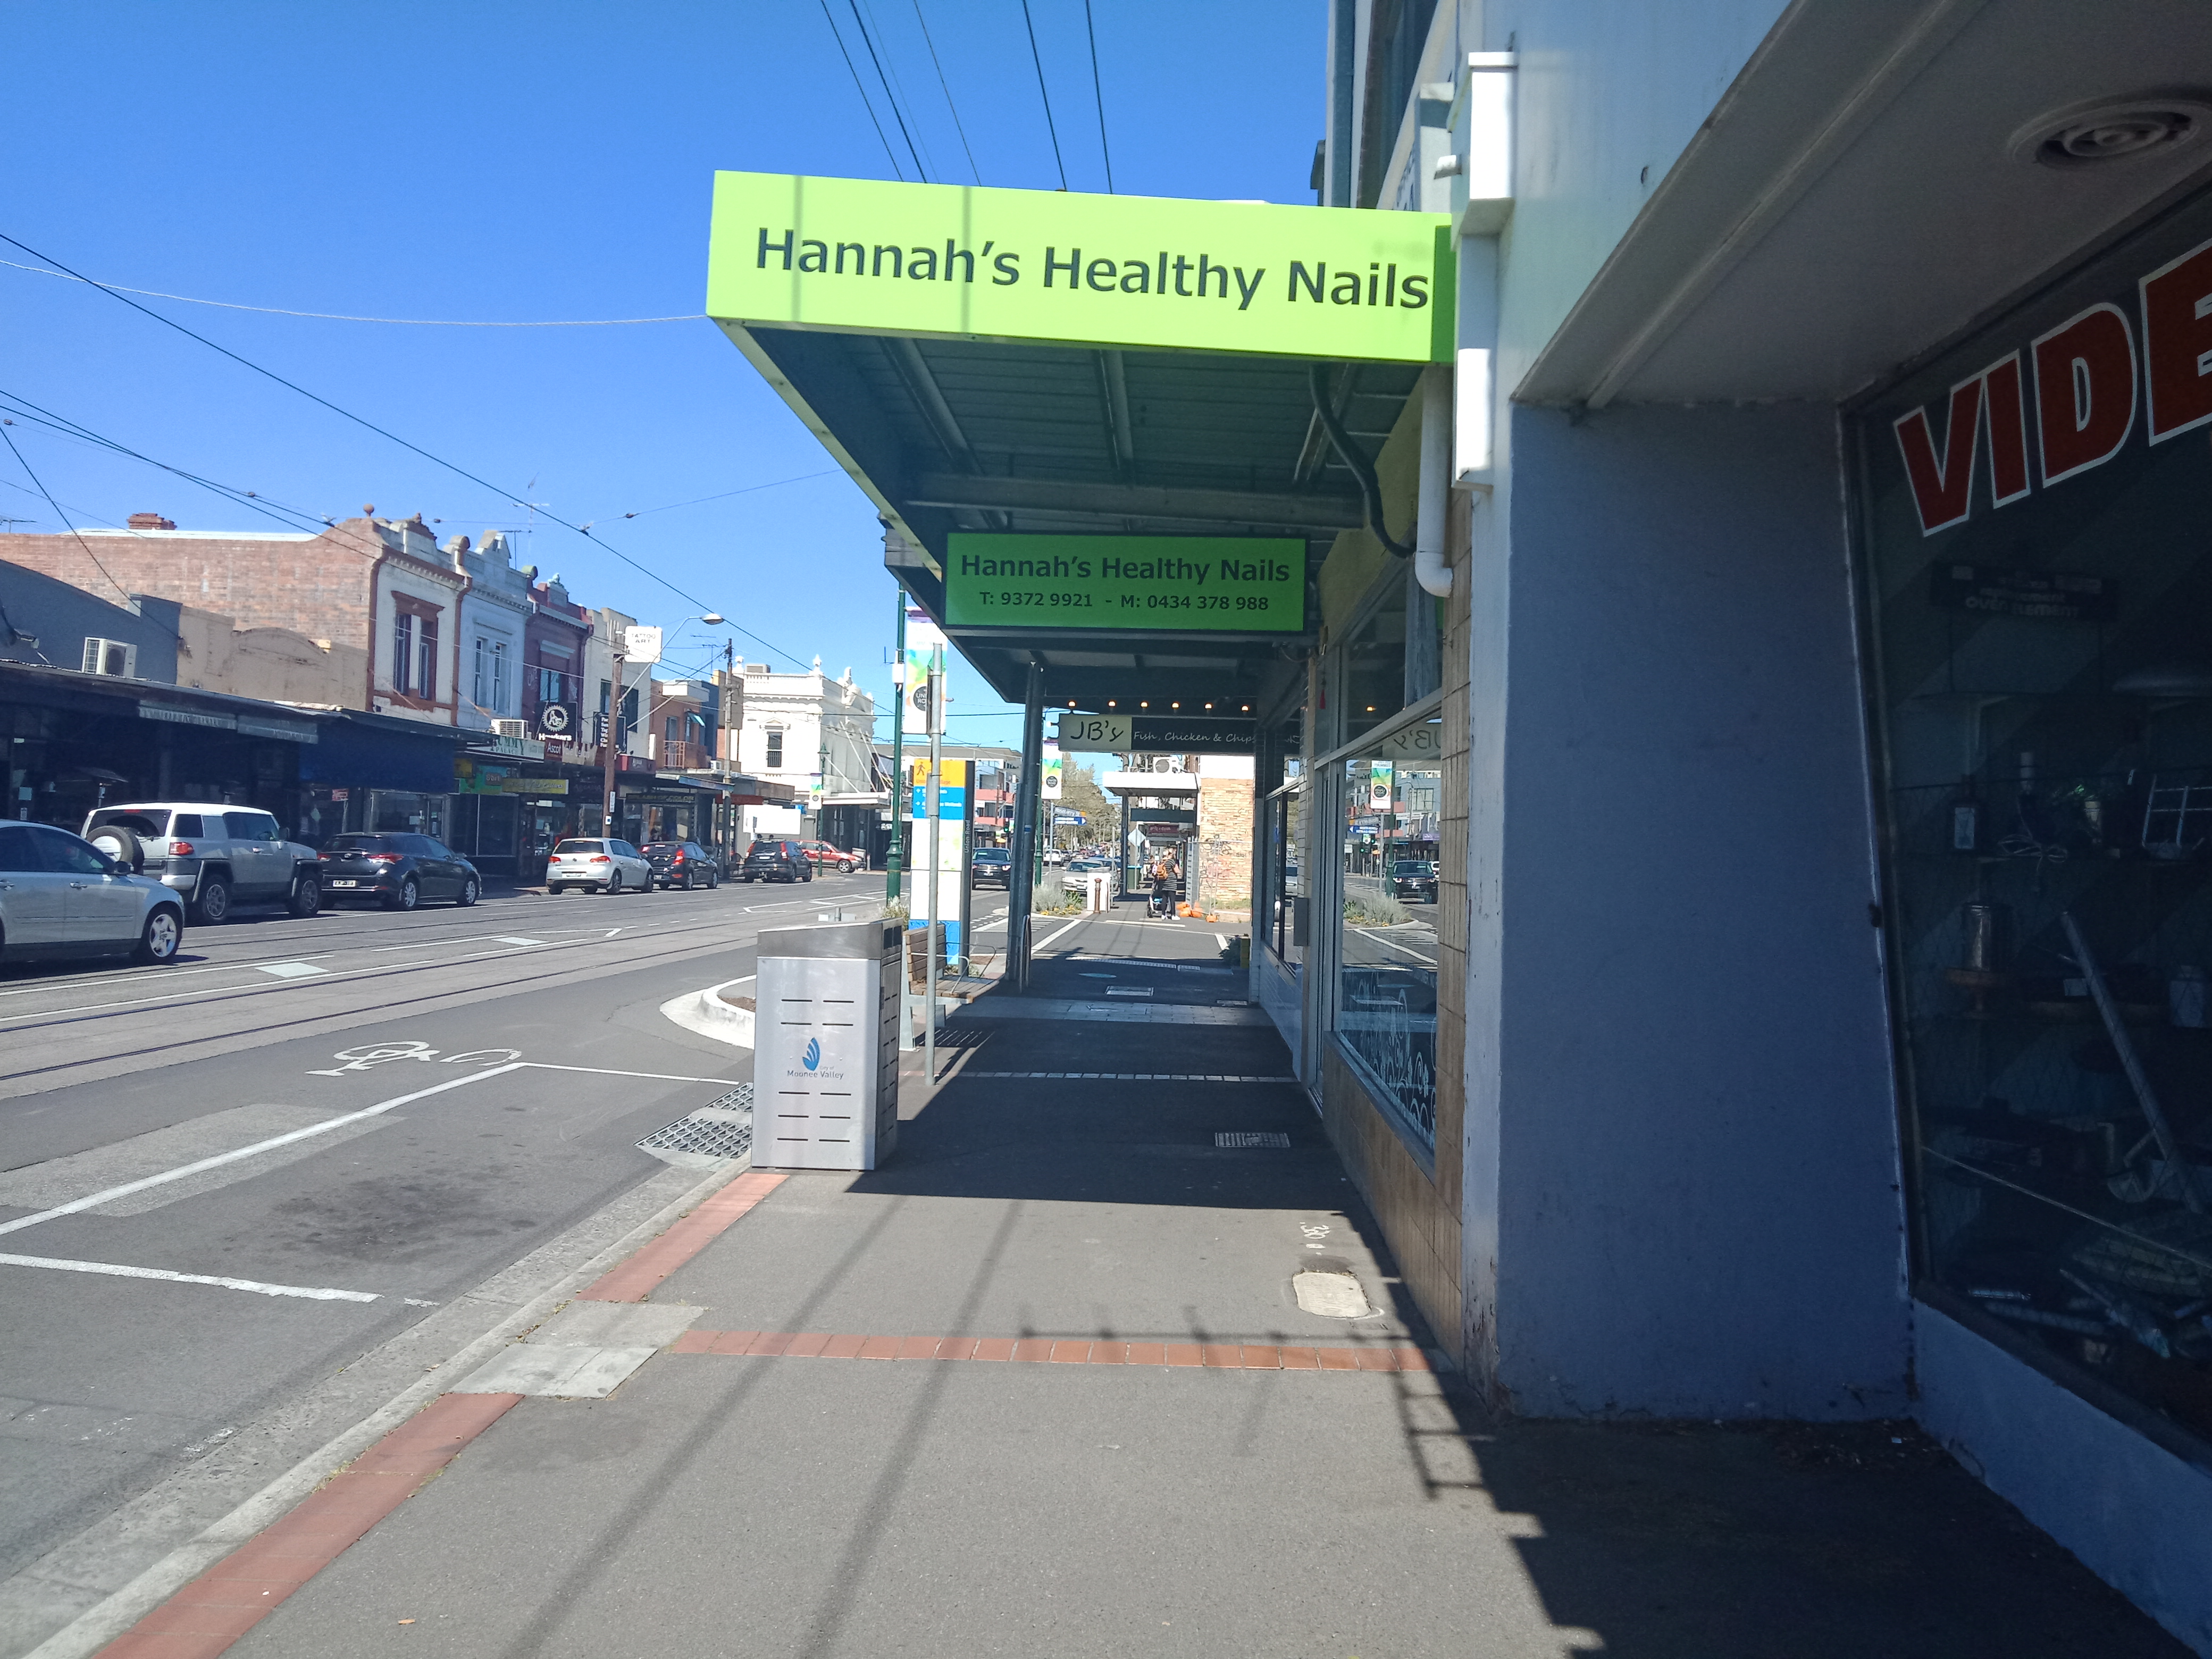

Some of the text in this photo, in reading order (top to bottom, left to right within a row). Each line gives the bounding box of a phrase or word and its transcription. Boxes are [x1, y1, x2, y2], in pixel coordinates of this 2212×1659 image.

[757, 228, 1428, 311] Hannah's Healthy Nails
[961, 555, 1291, 585] Hannah's Healthy Nails
[979, 592, 995, 605] T:
[1001, 592, 1044, 606] 9372
[1050, 593, 1092, 607] 9921
[1120, 594, 1140, 608] M:
[1146, 595, 1192, 609] 0434
[1196, 596, 1230, 610] 378
[1236, 597, 1269, 610] 988
[1164, 732, 1211, 741] Chicken
[547, 742, 562, 755] Ascot
[820, 1071, 844, 1080] Valley
